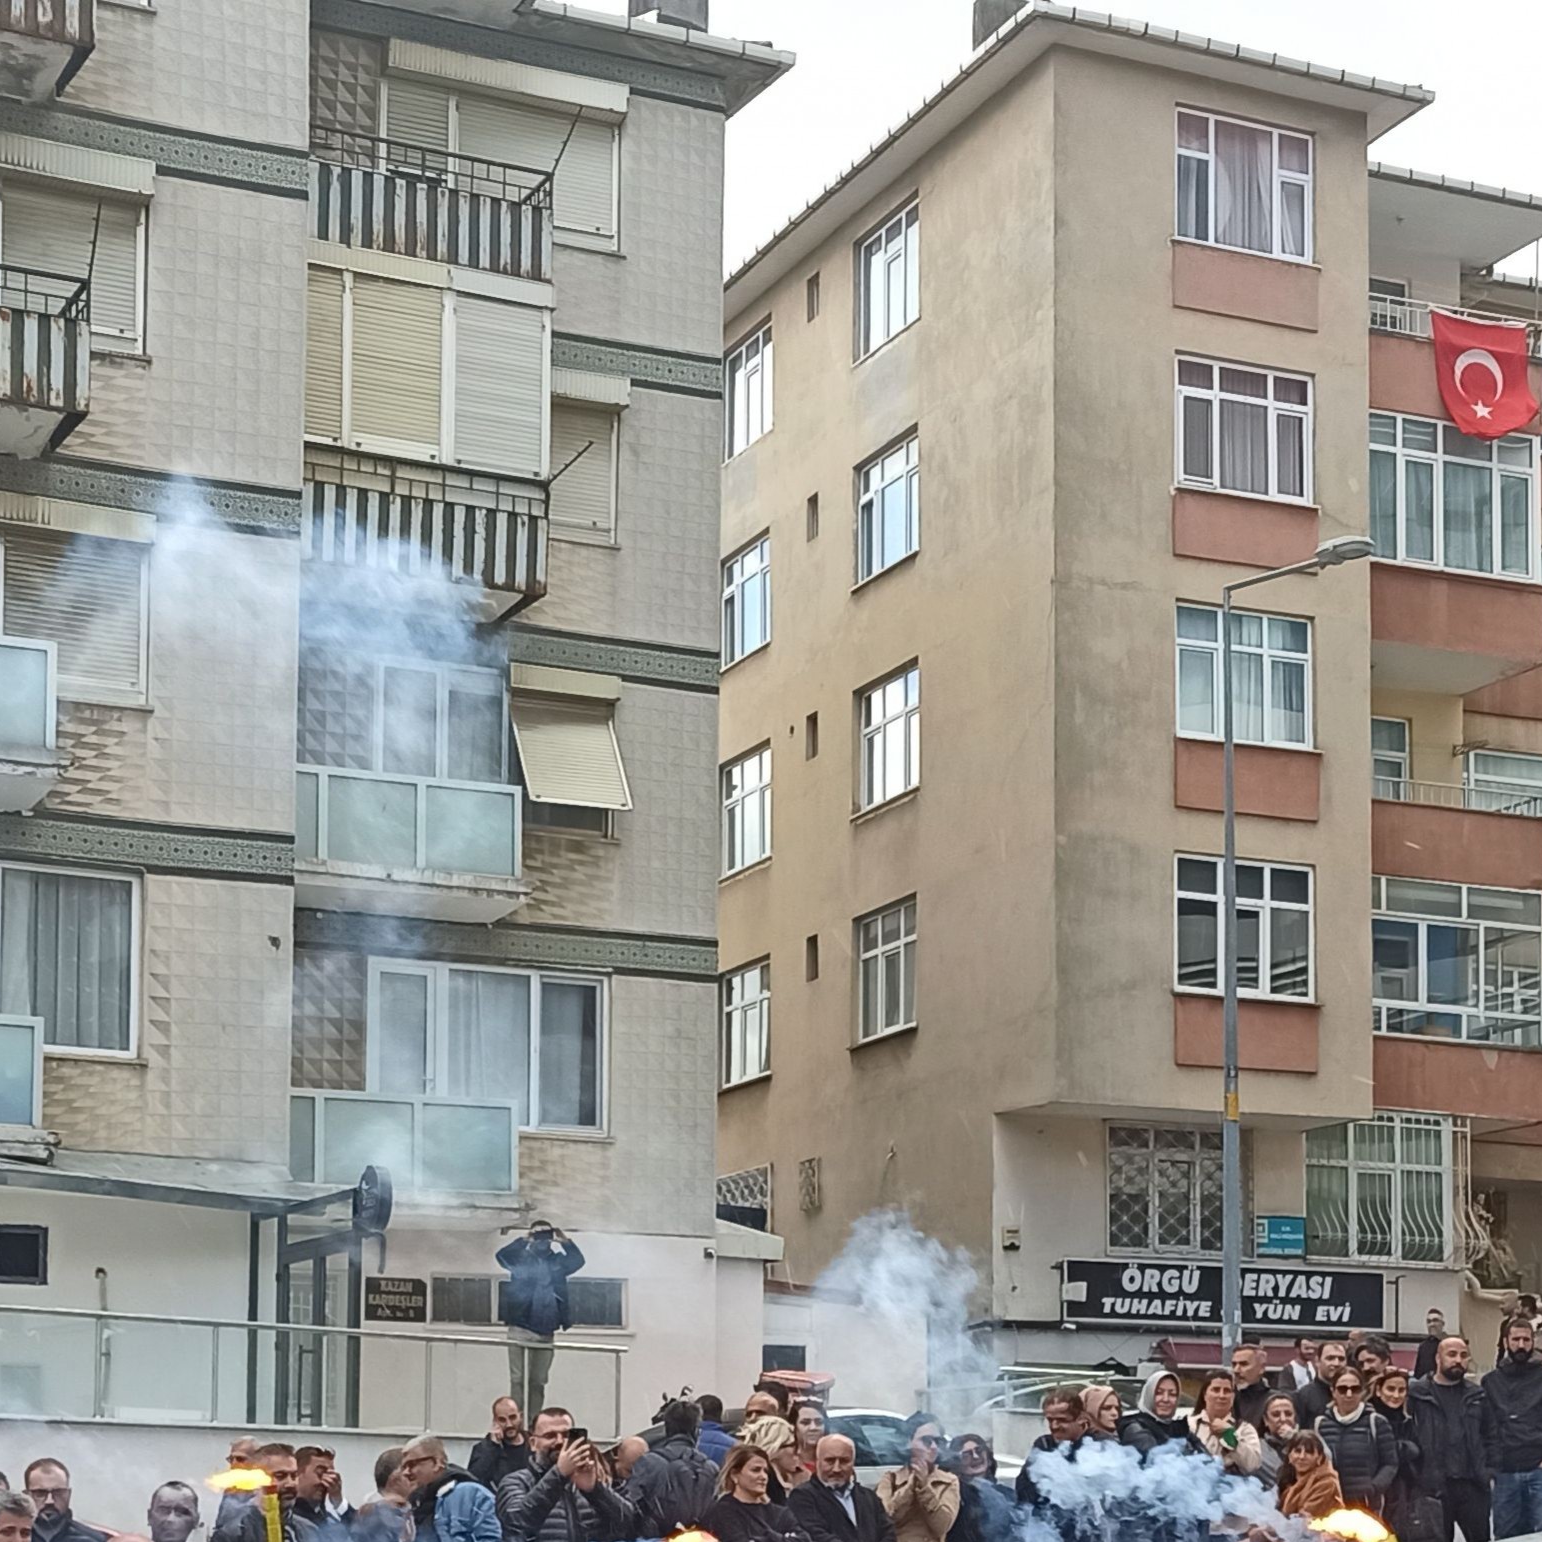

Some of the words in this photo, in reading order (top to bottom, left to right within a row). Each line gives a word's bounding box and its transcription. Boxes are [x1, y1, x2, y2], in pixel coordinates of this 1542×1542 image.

[1121, 1263, 1201, 1295] ÖRGÜ
[1240, 1272, 1333, 1301] ERYASI
[1101, 1295, 1213, 1318] TUHAFİYE
[1253, 1300, 1301, 1321] YÜN
[1315, 1302, 1351, 1323] EVİ
